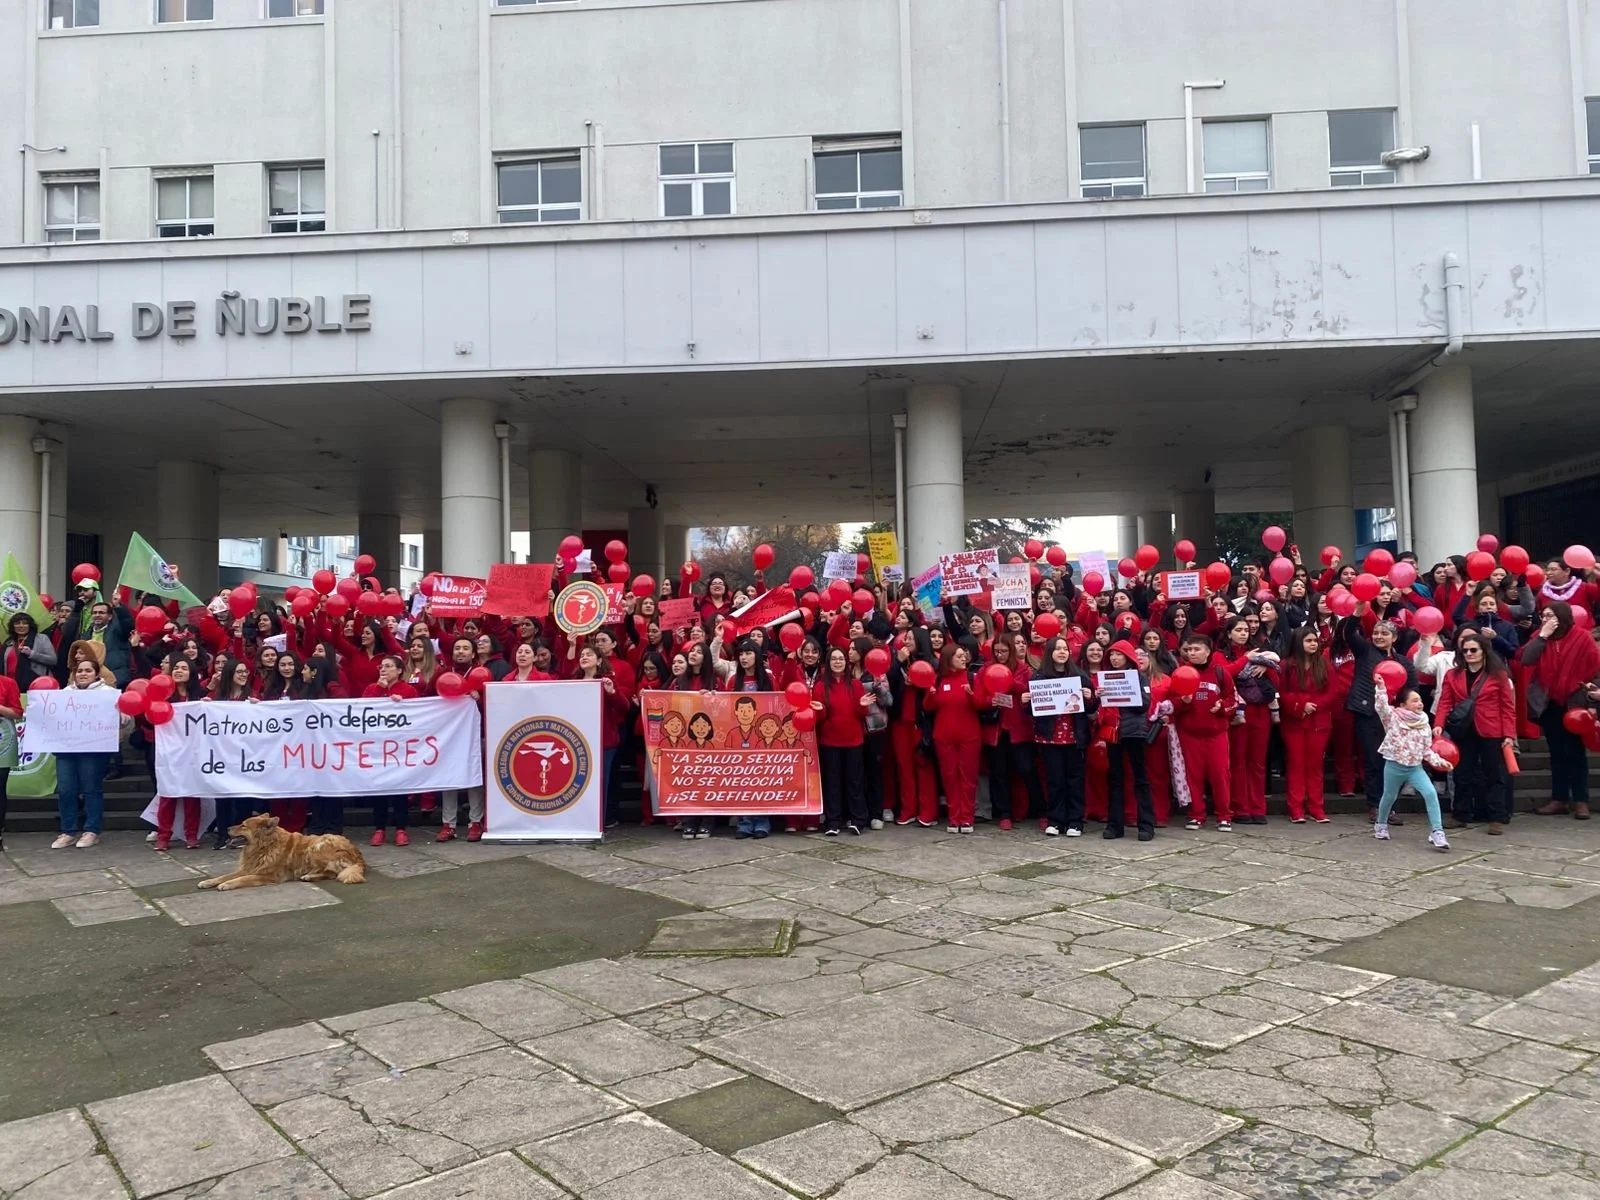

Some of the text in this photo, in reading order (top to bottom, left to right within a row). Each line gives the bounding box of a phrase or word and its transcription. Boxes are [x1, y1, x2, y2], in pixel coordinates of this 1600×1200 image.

[131, 300, 197, 339] DE
[215, 290, 372, 336] ÑUBLE
[433, 576, 453, 593] NO
[1000, 578, 1023, 588] UCHA
[469, 595, 483, 607] 150
[996, 597, 1027, 607] FEMINISTA
[41, 692, 57, 717] Yo
[57, 720, 73, 732] MI
[305, 710, 332, 729] en
[339, 705, 412, 734] defensa
[201, 735, 440, 775] de las MUJERES
[500, 721, 587, 779] COLEGIO DE MATRONAS Y MATRONES DE CHILE
[694, 753, 743, 764] SALUD
[746, 753, 799, 764] SEXUAL
[671, 765, 794, 776] Y REPRODUCTIVA
[672, 776, 693, 786] NO
[697, 776, 717, 786] SE
[506, 783, 531, 807] CONSEJO
[531, 798, 564, 810] REGIONAL
[665, 790, 798, 804] ¡¡SE DEFIENDE!!
